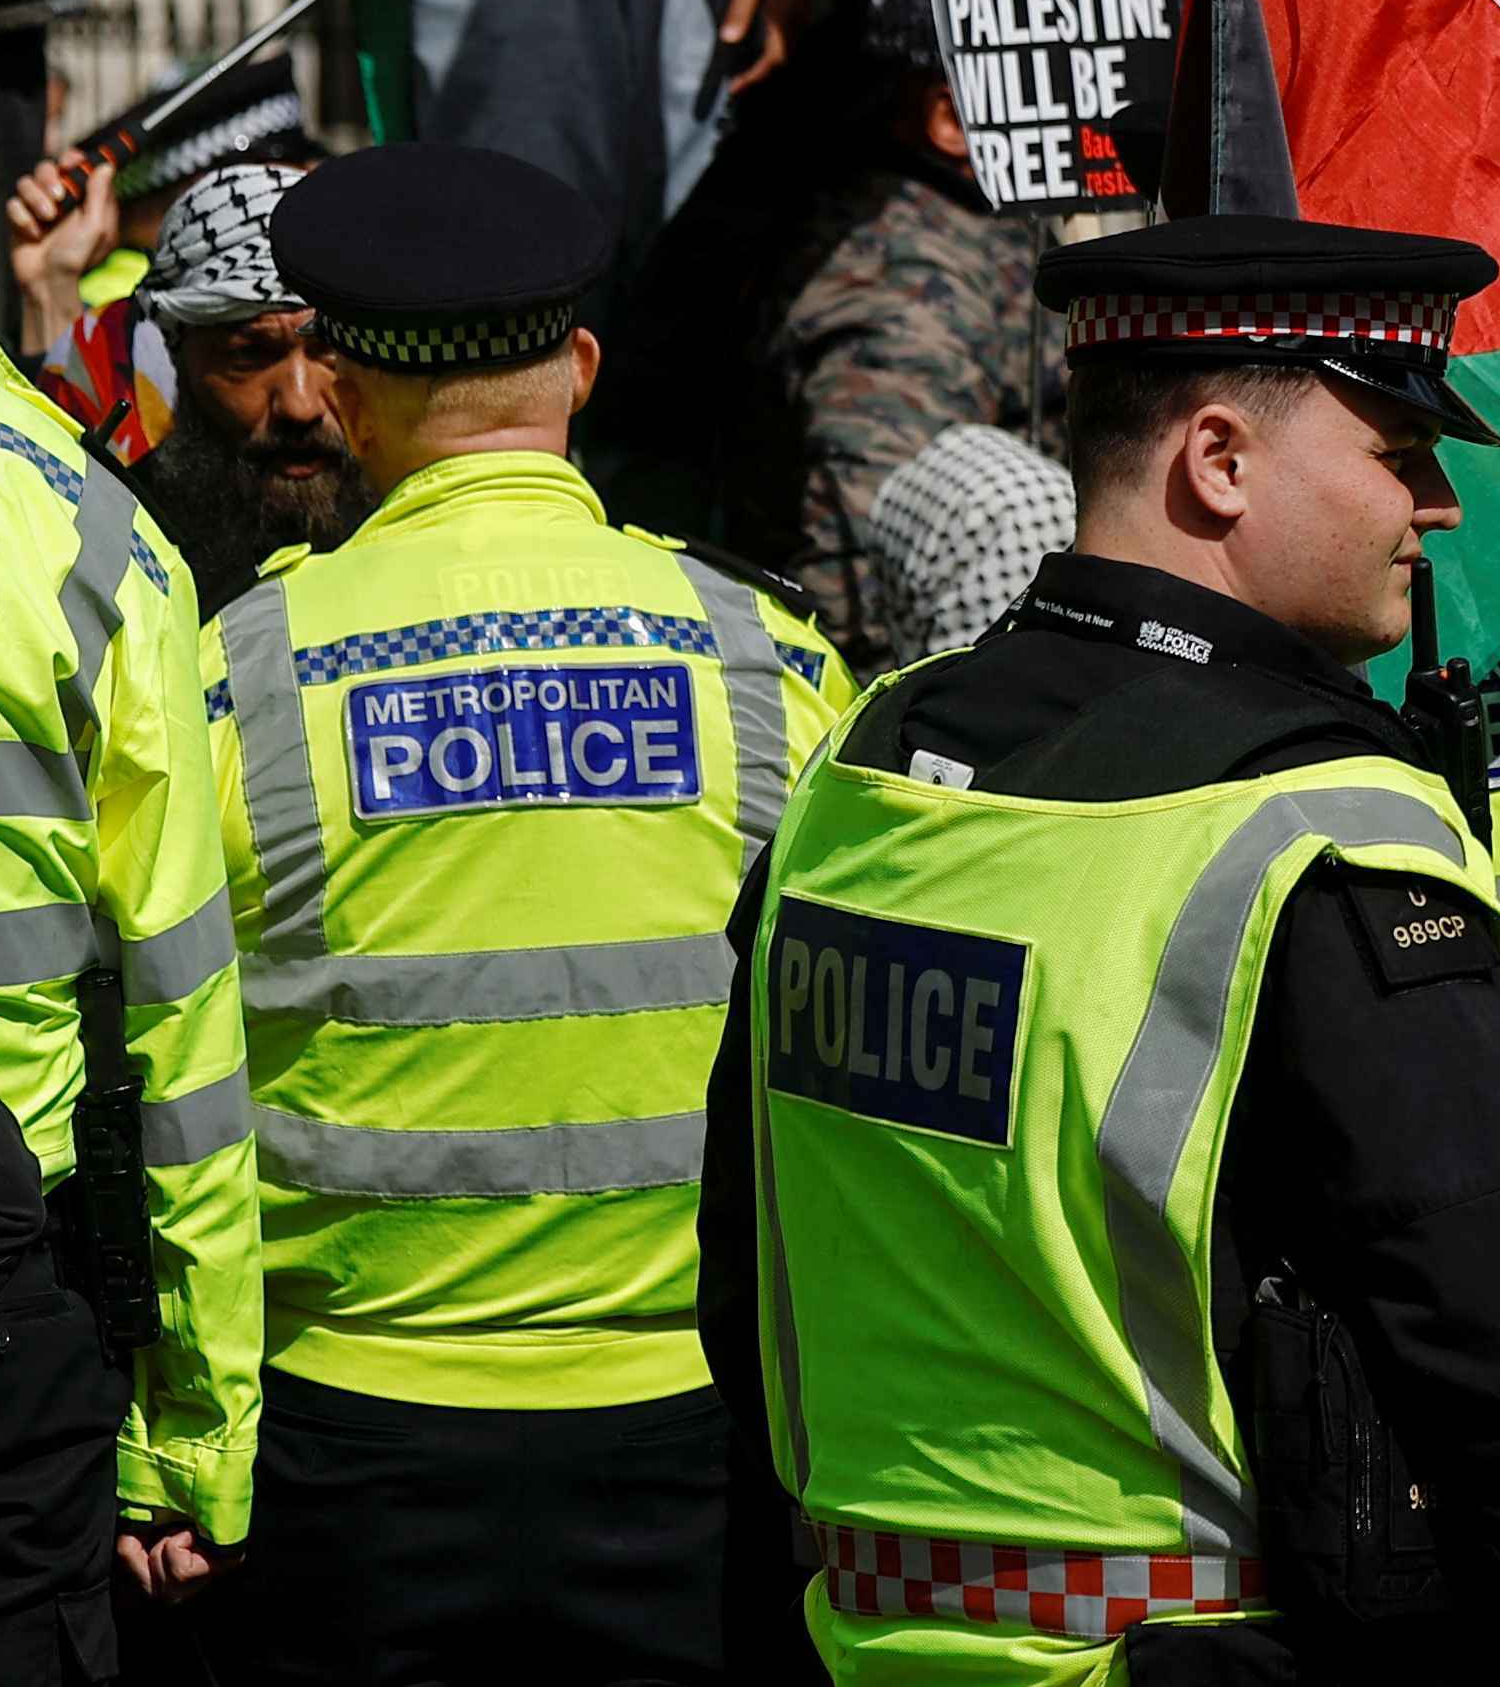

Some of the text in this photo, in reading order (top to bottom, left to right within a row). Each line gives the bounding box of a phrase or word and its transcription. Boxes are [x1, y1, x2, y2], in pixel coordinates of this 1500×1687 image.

[952, 46, 1133, 125] WILL BE
[967, 124, 1078, 205] FREE
[454, 566, 618, 609] POLICE
[1163, 633, 1211, 660] POLICE
[364, 676, 678, 726] METROPOLITAN
[369, 721, 684, 800] POLICE
[1392, 915, 1466, 948] 989CP
[780, 935, 1002, 1102] POLICE
